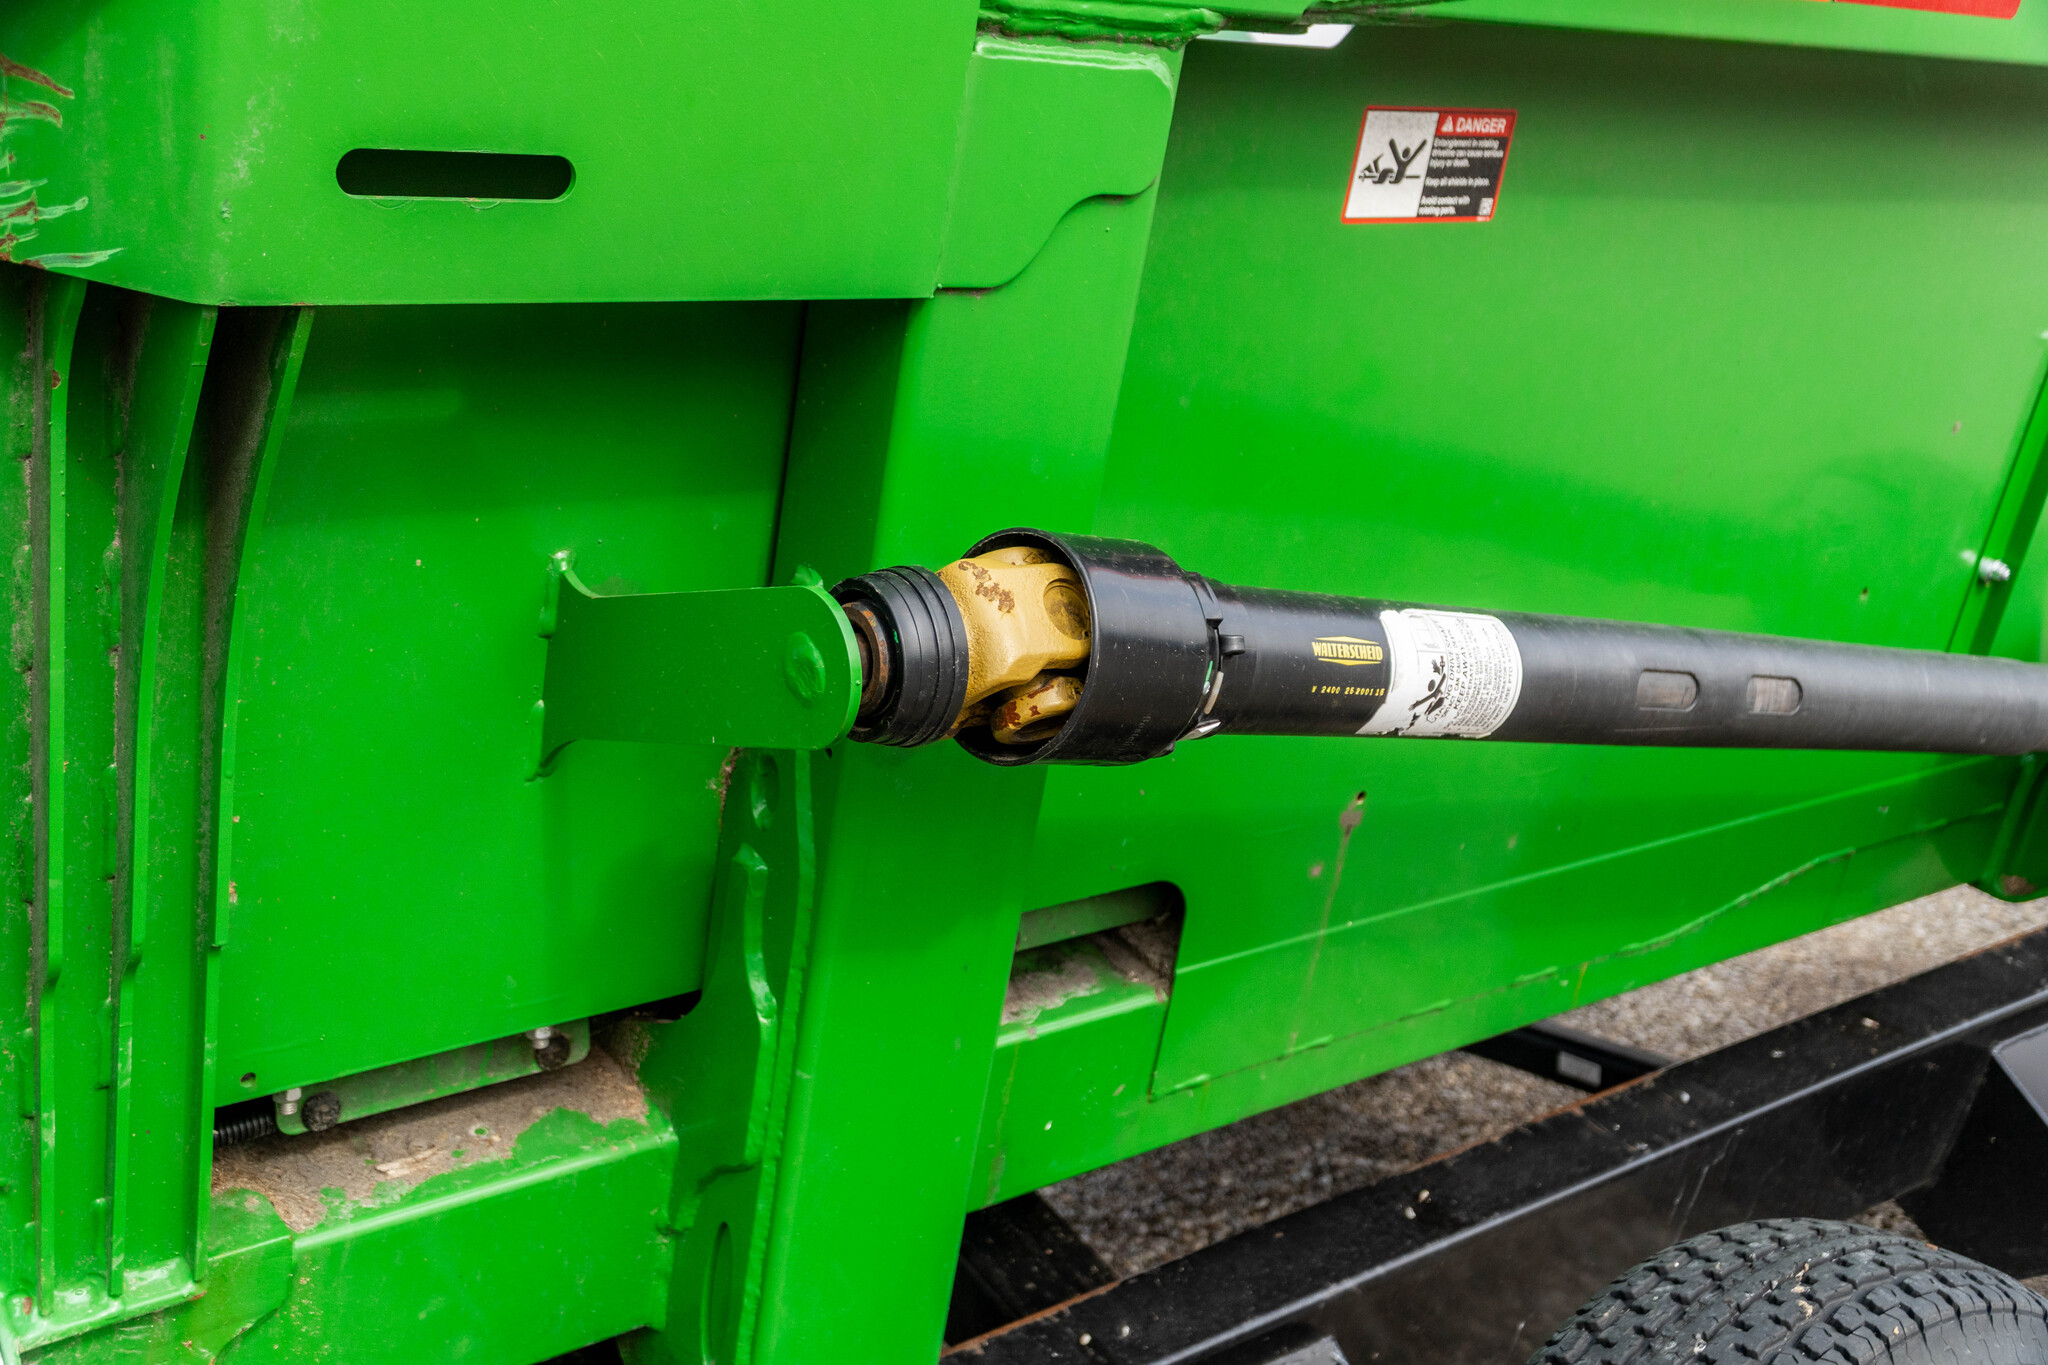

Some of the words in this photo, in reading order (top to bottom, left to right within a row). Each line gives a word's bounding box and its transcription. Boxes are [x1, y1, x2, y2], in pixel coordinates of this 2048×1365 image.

[1456, 117, 1506, 133] DANGER
[1312, 642, 1383, 660] WALTERSCHEID
[1321, 686, 1340, 694] 2400
[1462, 662, 1473, 701] OPERATE
[1452, 681, 1466, 709] KEEP
[1502, 686, 1511, 703] USE
